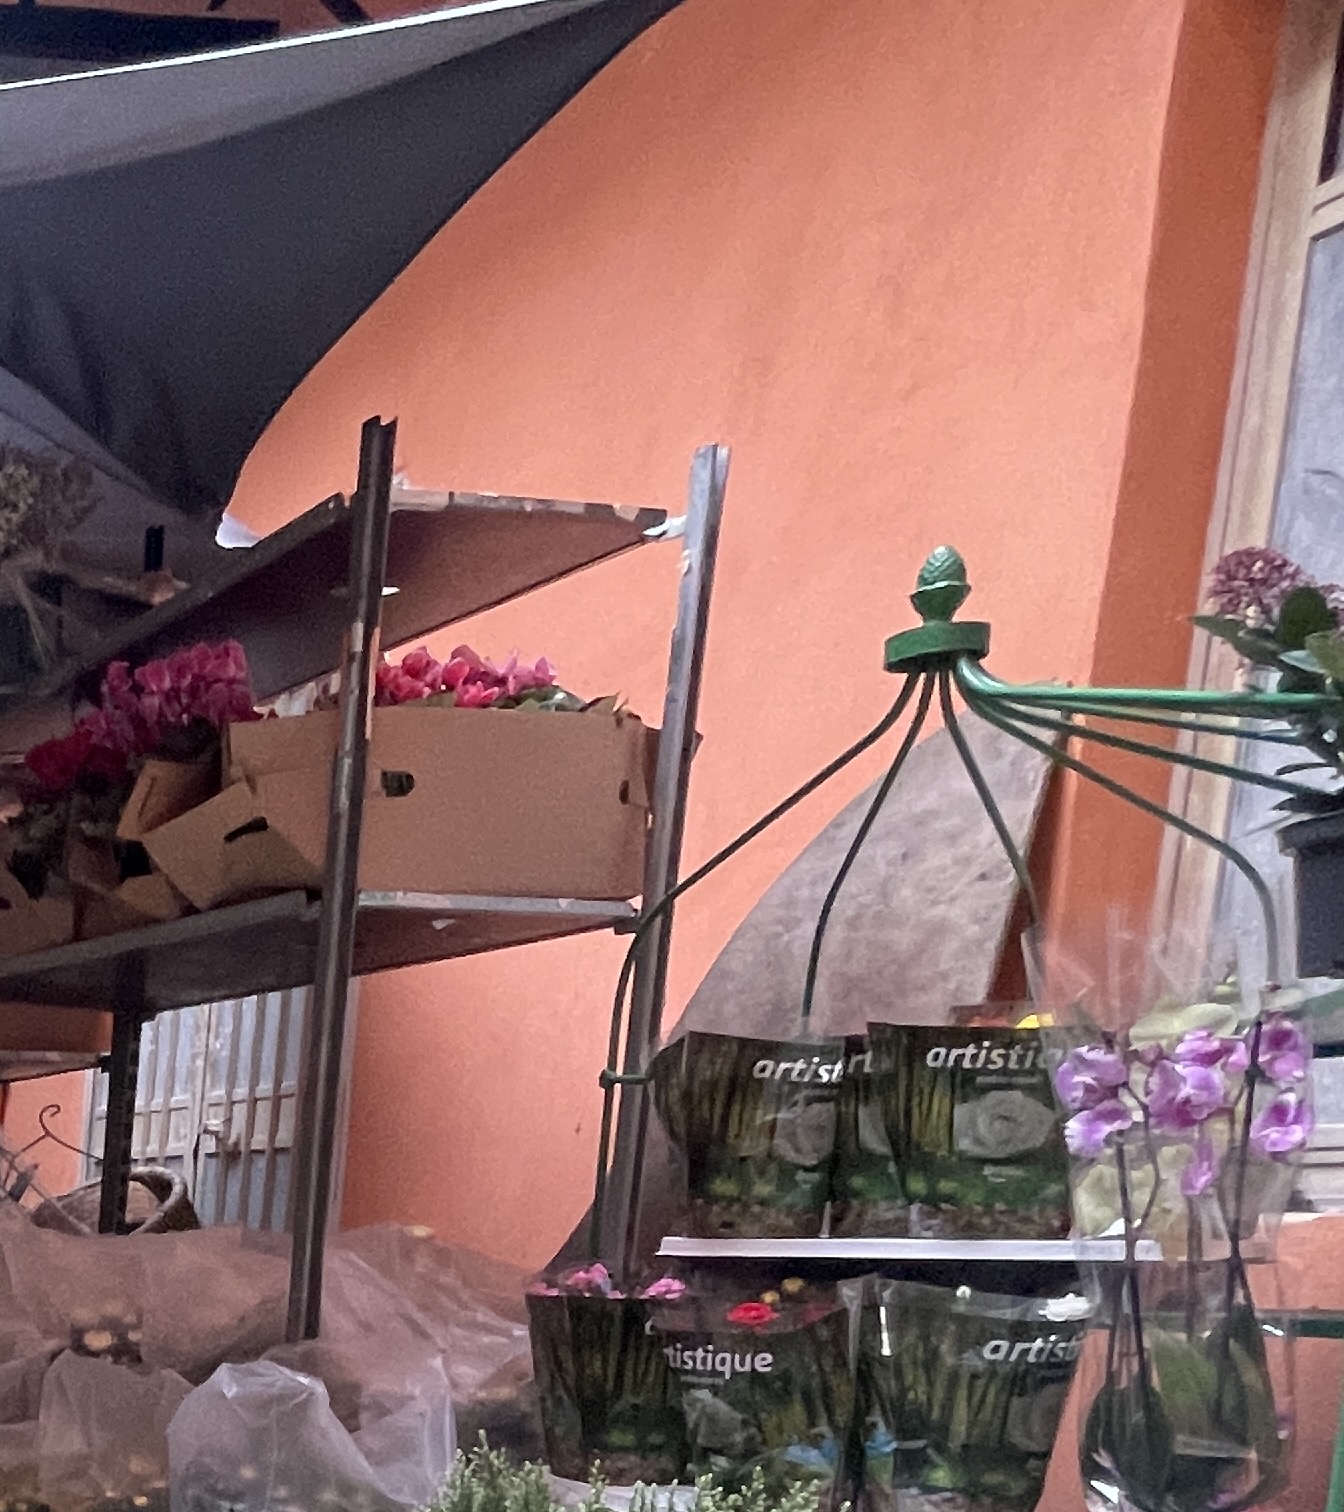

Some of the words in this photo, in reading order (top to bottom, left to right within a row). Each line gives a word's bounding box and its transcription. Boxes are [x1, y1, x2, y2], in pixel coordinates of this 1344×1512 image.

[752, 1056, 844, 1083] artist
[925, 1040, 1054, 1070] artisti
[662, 1342, 774, 1380] tistique
